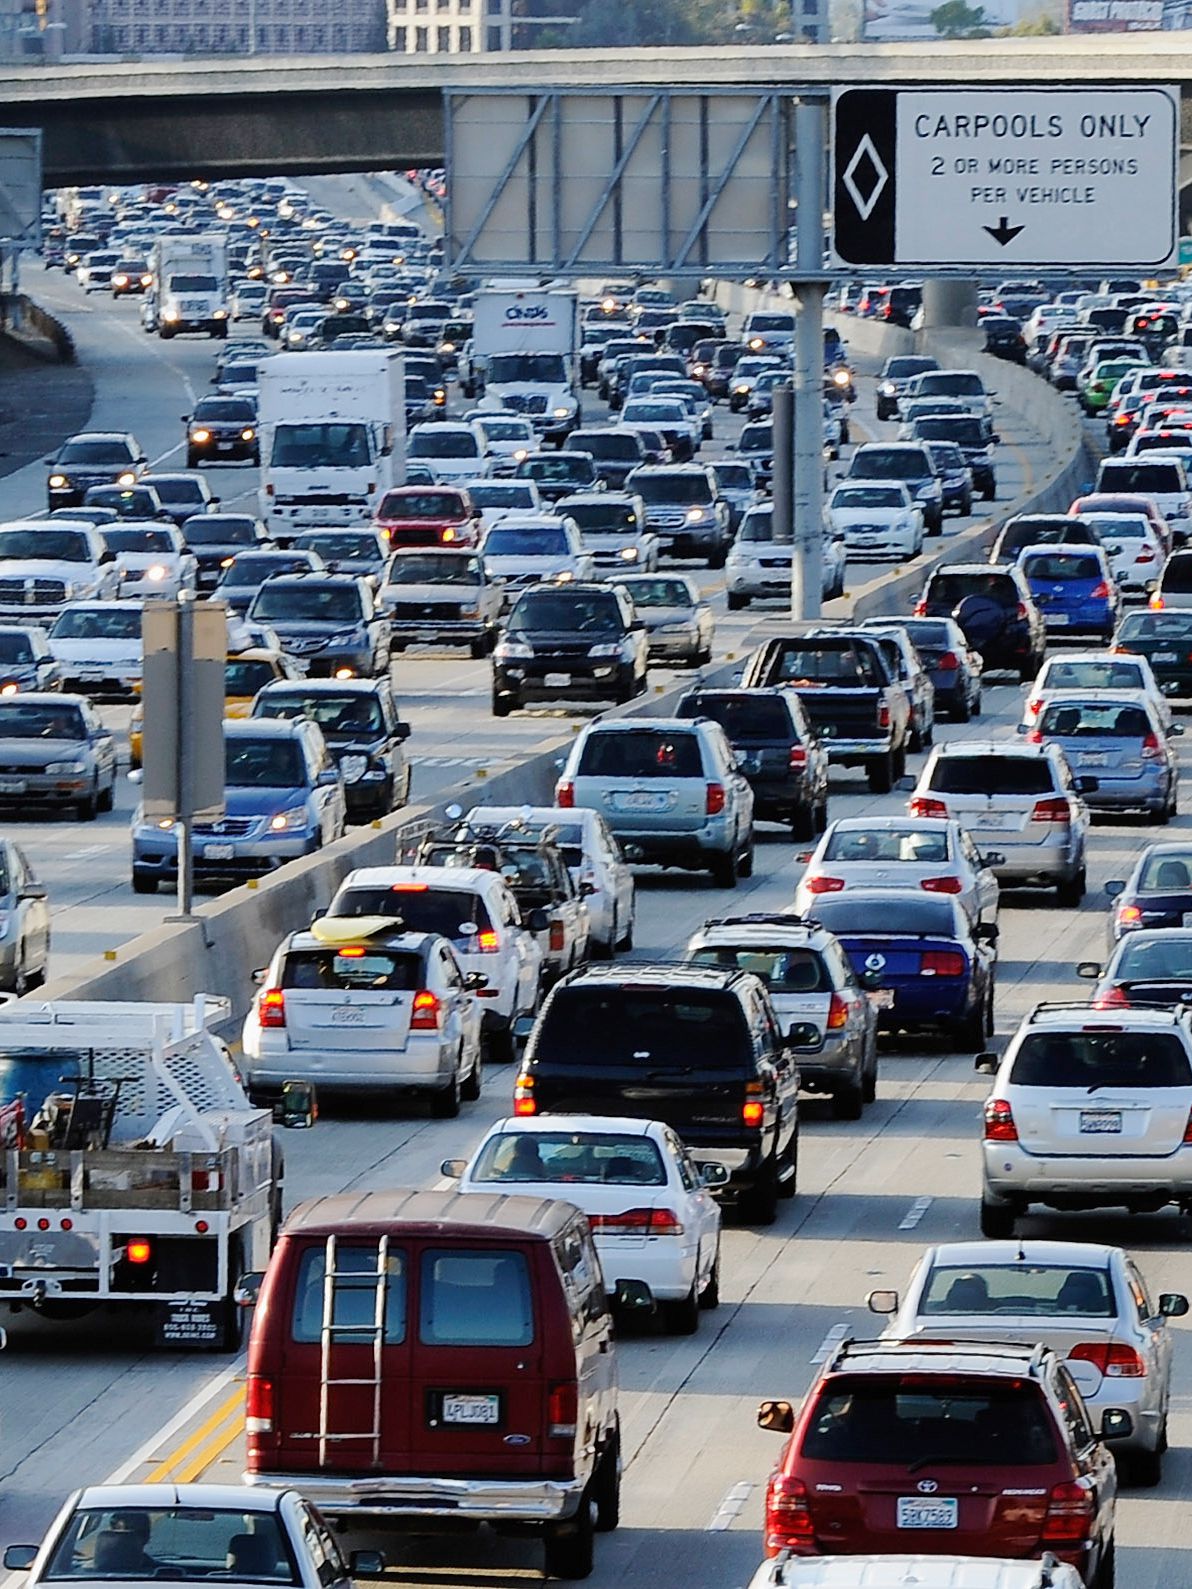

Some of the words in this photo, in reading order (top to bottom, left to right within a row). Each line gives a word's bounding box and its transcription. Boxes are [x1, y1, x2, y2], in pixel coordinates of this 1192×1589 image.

[914, 113, 1063, 139] CARPOOLS
[1080, 113, 1151, 138] ONLY
[930, 155, 946, 176] 2
[953, 157, 979, 175] OR
[988, 157, 1040, 175] MORE
[1049, 157, 1139, 176] PERSONS
[970, 186, 1007, 204] PER
[1016, 186, 1096, 204] VEHICLE
